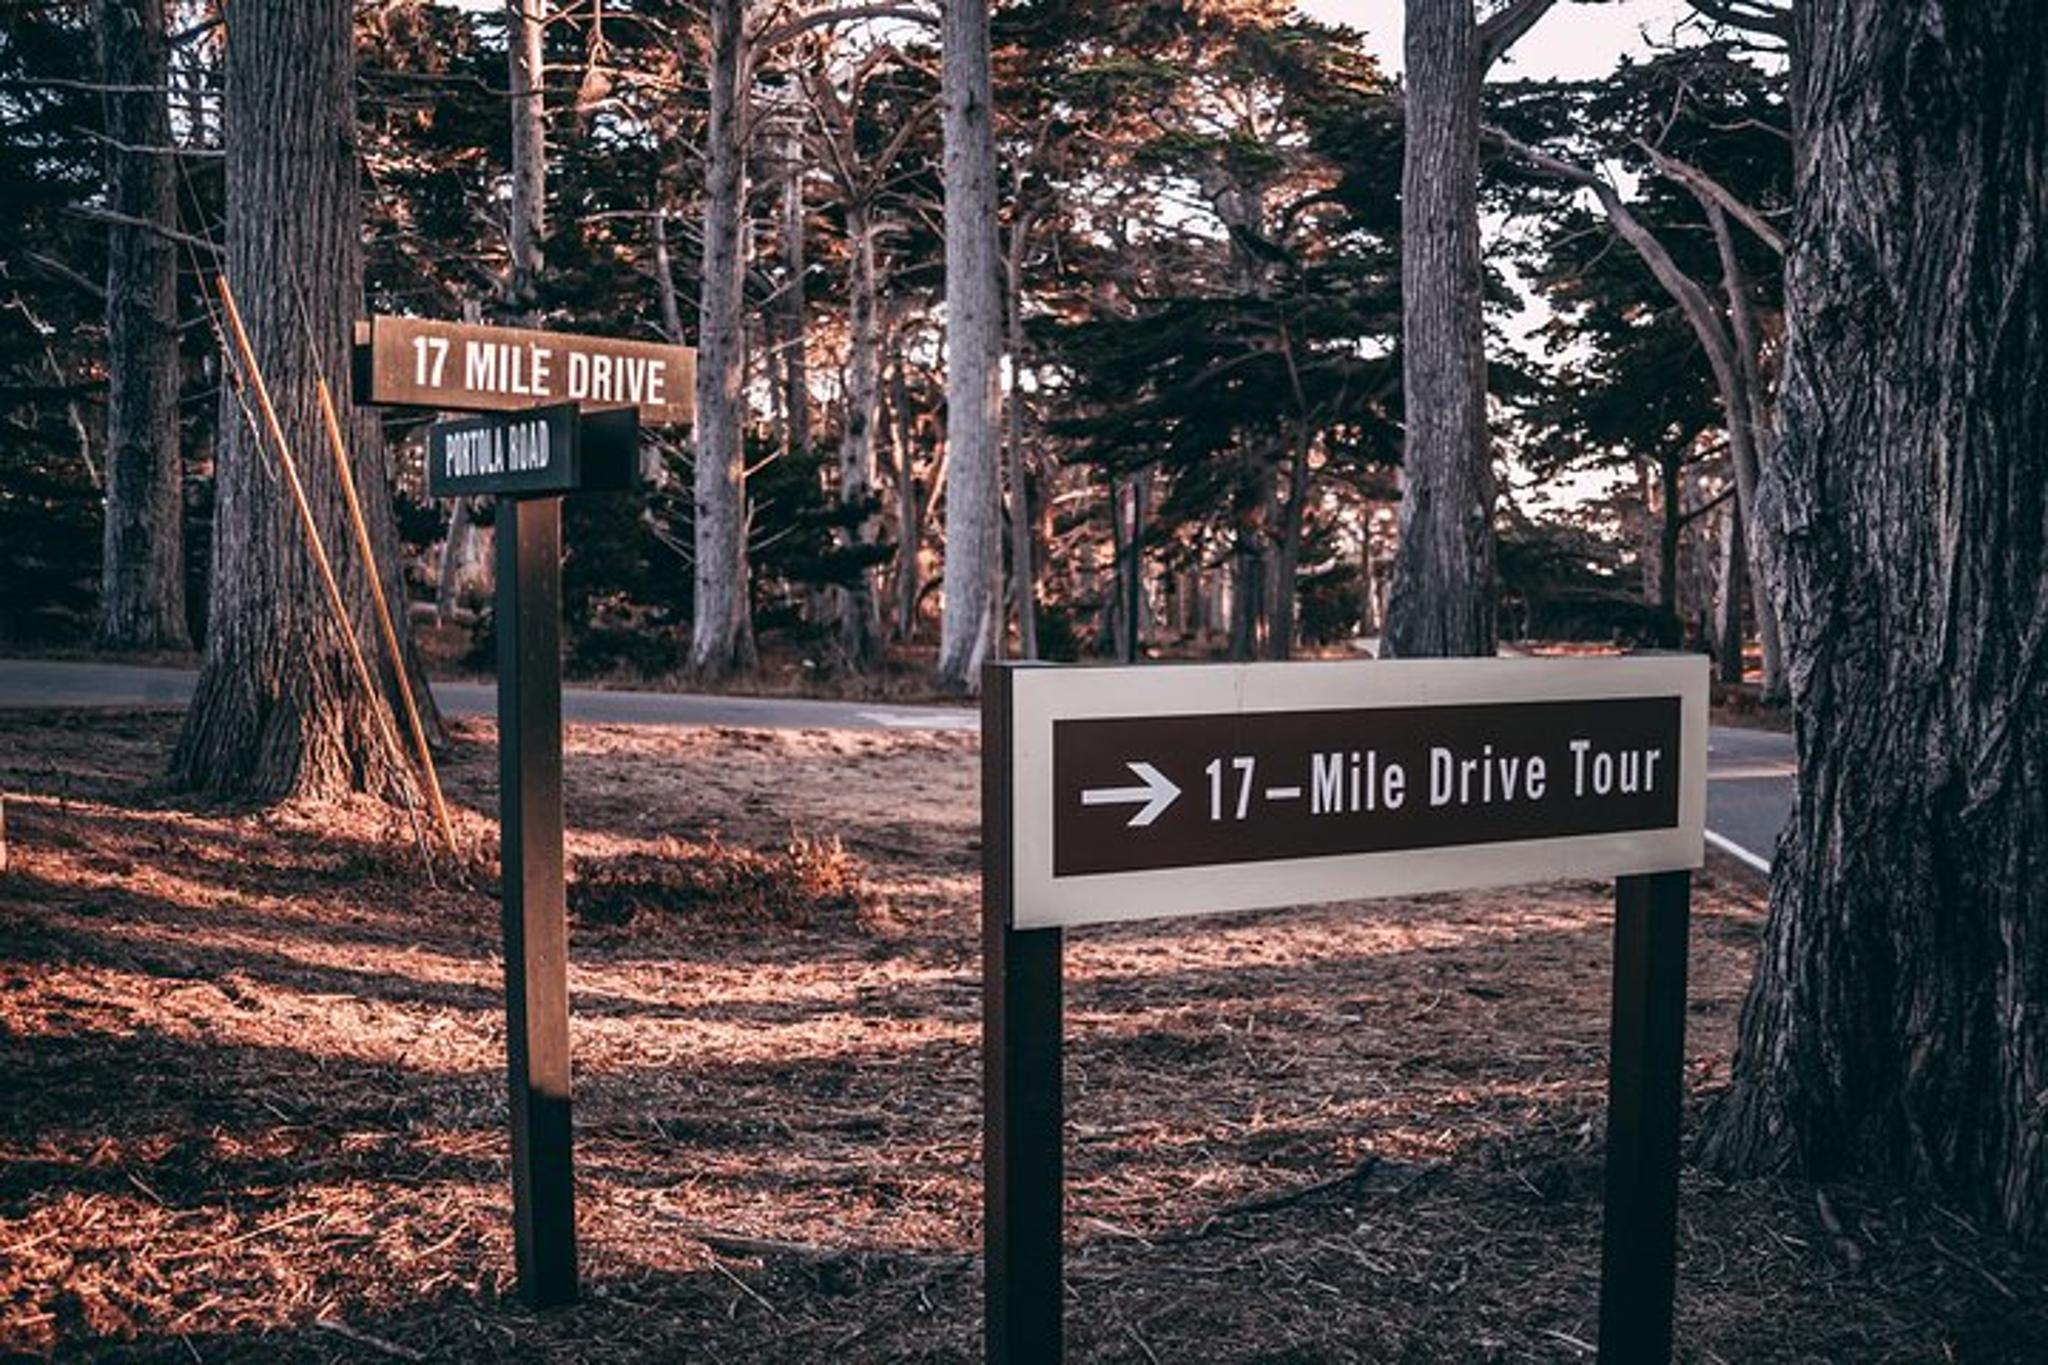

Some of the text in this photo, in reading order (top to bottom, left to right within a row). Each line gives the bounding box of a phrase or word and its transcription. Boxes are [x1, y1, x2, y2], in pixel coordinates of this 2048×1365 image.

[413, 335, 667, 404] 17 MILE DRIVE
[508, 420, 550, 470] ROAD
[1429, 744, 1547, 807] Drive
[1569, 739, 1661, 798] Tour
